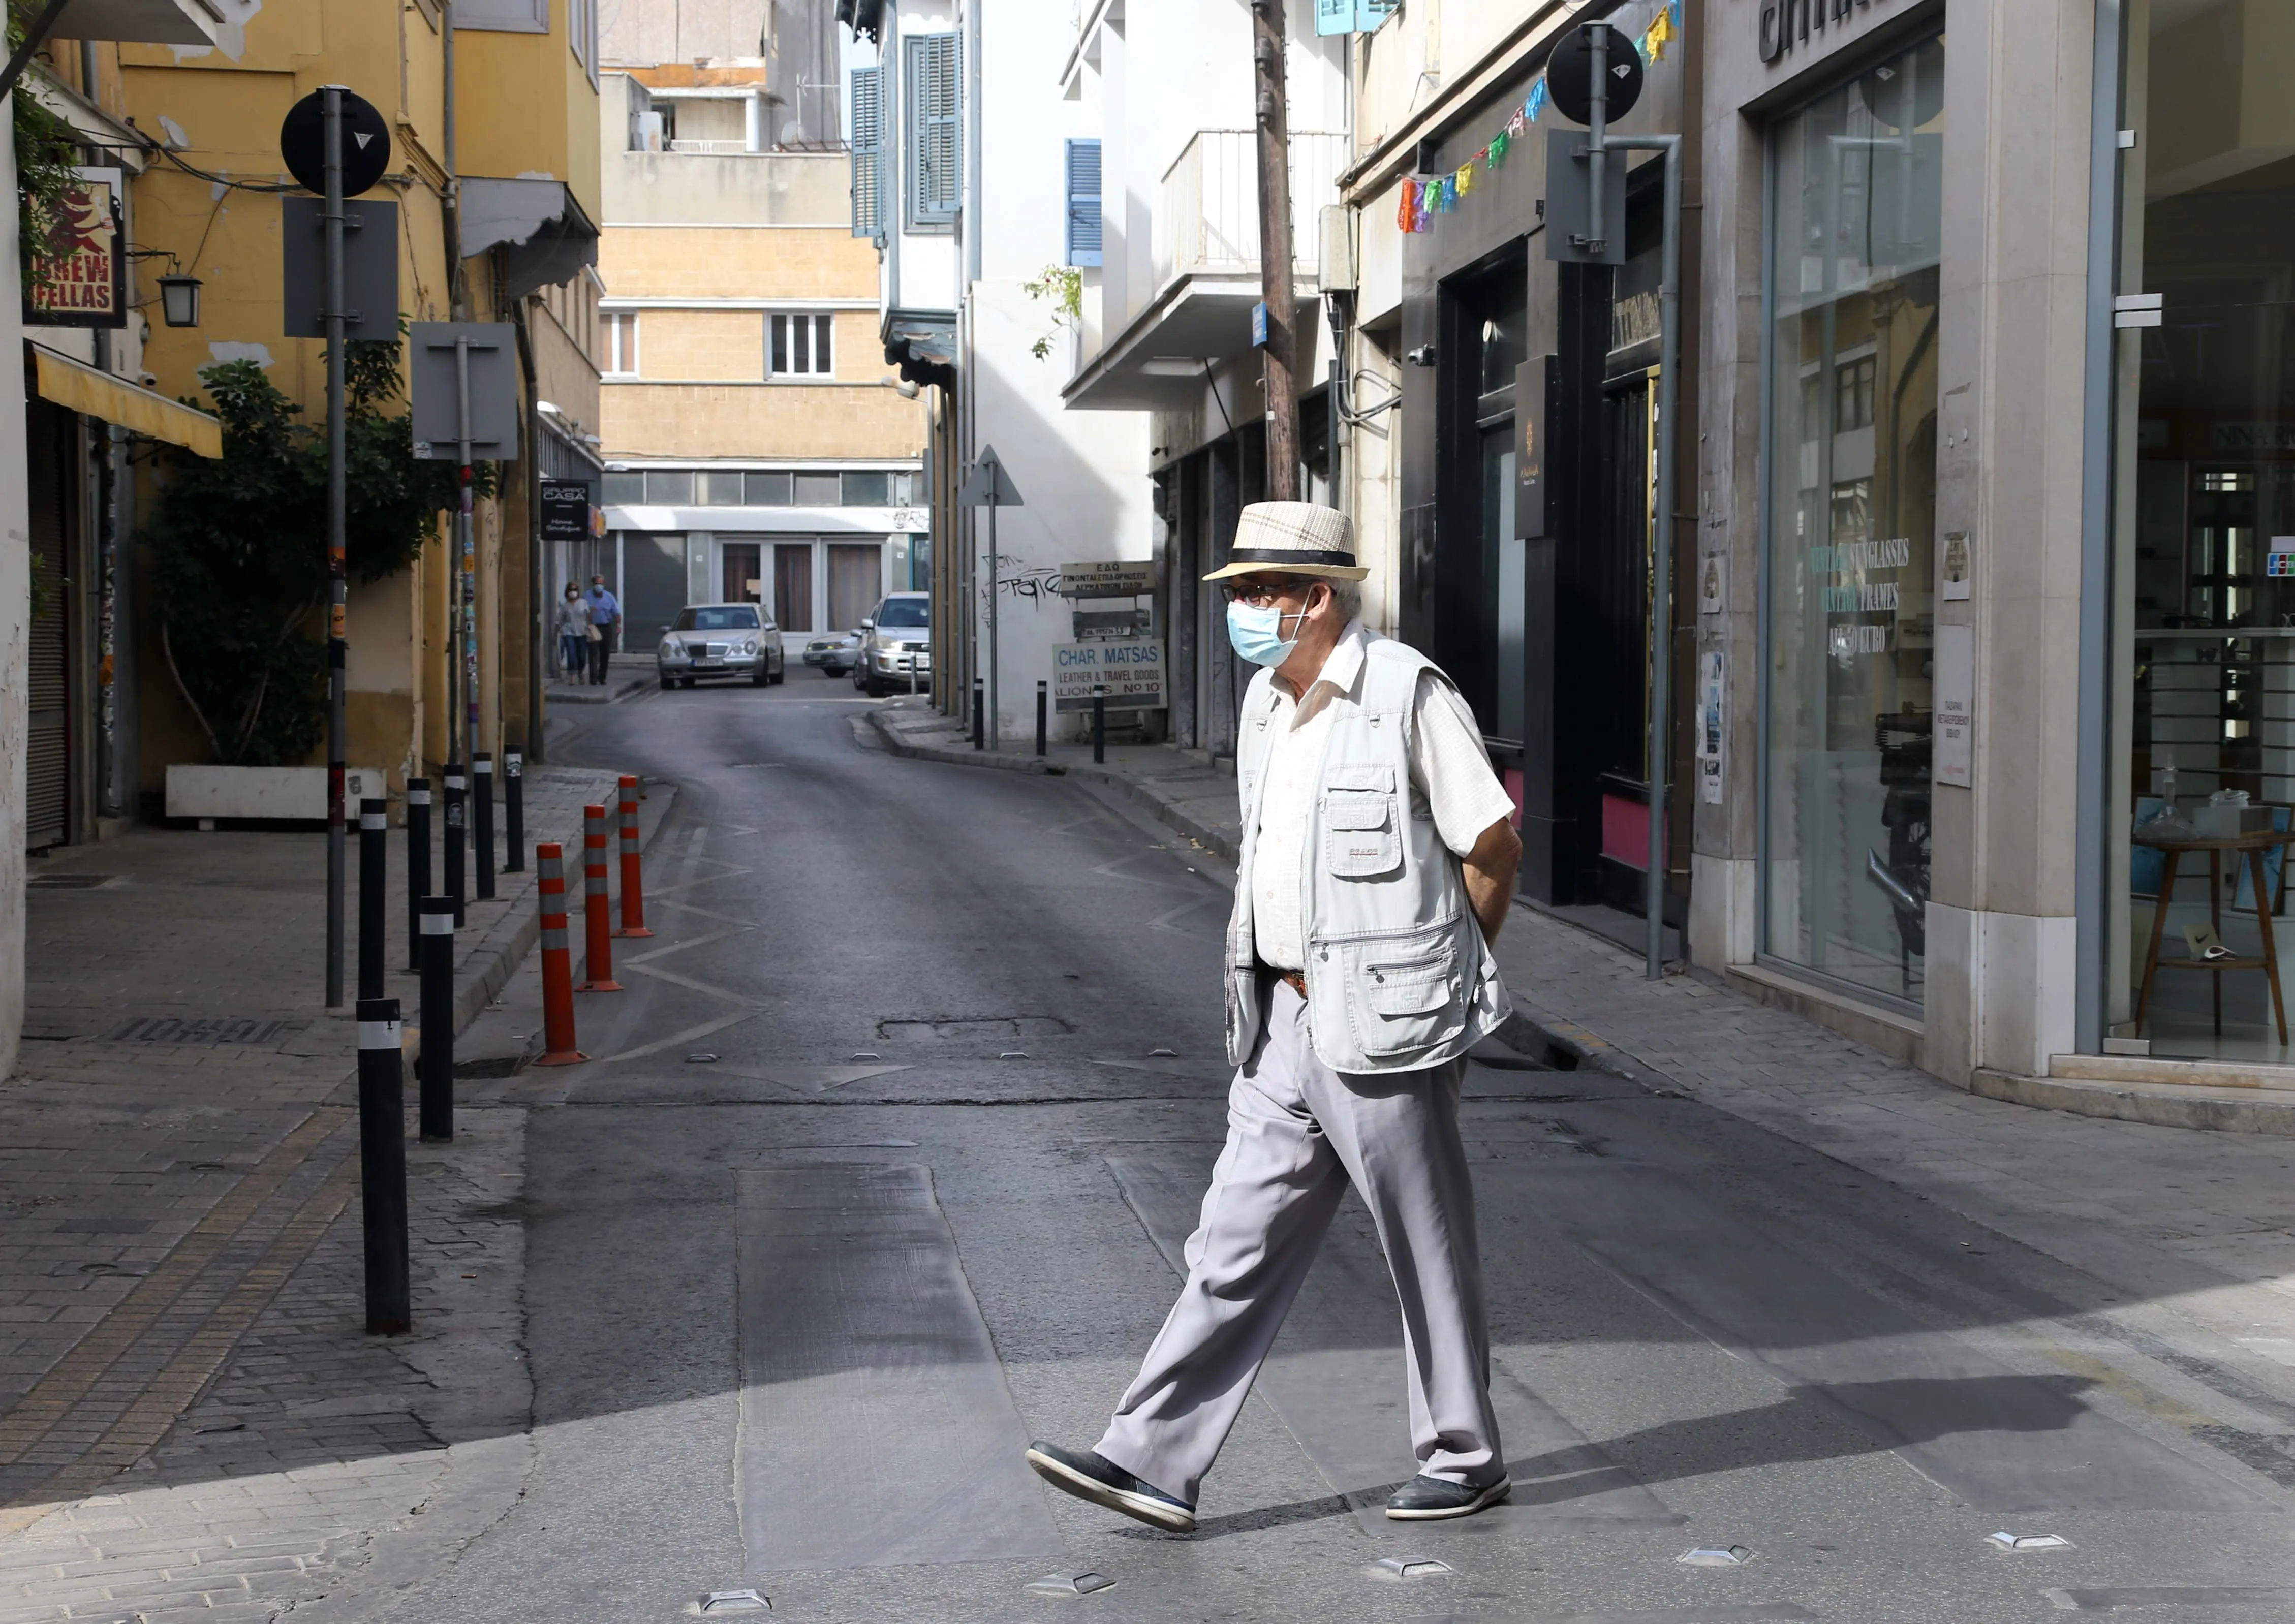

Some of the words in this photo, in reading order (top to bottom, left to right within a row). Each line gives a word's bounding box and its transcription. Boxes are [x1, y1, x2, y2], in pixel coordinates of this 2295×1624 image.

[37, 255, 109, 282] BREW
[37, 283, 109, 308] FELLAS
[543, 492, 585, 501] CASA
[1850, 538, 1909, 570] SUNGLASSES
[1097, 563, 1120, 572] ΕΔΩ
[1860, 582, 1899, 611] FRAMES
[1860, 626, 1885, 653] EURO
[1059, 649, 1099, 666] CHAR.
[1105, 646, 1158, 664] MATSAS
[1059, 672, 1092, 683] LEATHER
[1095, 671, 1100, 682] &
[1104, 670, 1132, 682] TRAVEL
[1134, 669, 1159, 680] GOODS
[1056, 685, 1112, 696] LIONS
